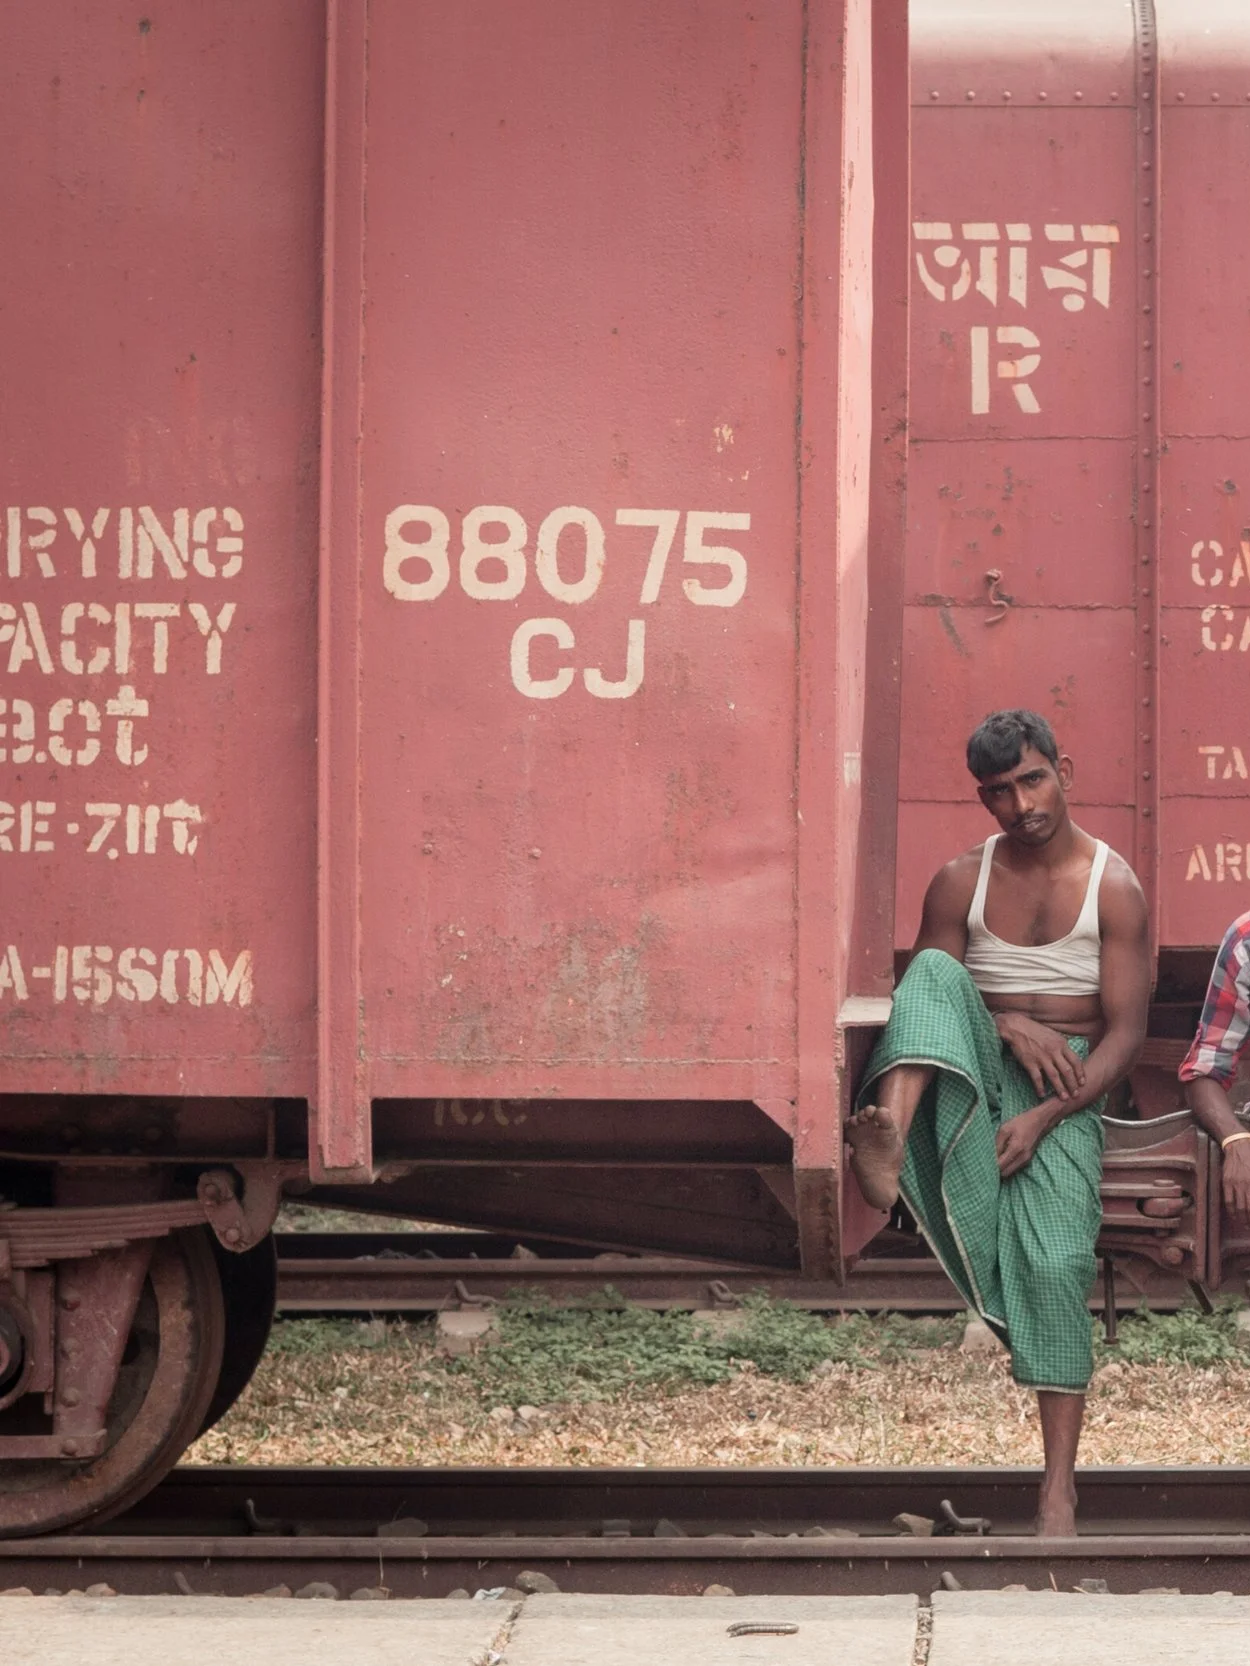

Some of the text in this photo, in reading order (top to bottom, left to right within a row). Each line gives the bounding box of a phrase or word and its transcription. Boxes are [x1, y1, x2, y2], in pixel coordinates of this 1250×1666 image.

[970, 326, 1041, 415] R
[0, 506, 244, 579] RYING
[383, 504, 751, 608] 88075
[510, 617, 646, 698] CJ
